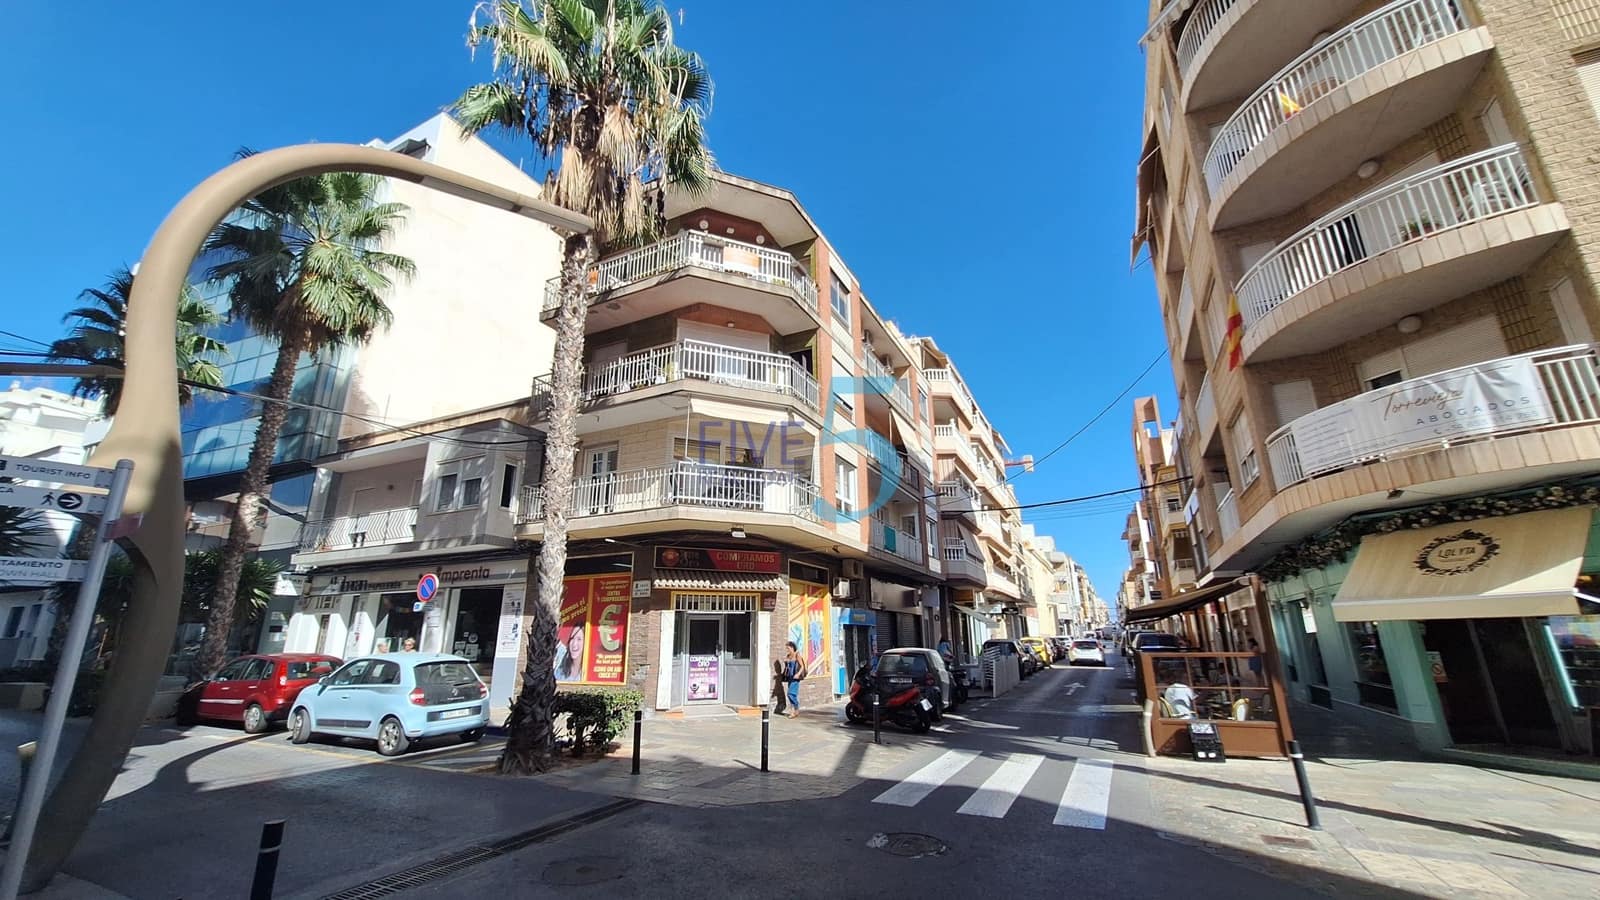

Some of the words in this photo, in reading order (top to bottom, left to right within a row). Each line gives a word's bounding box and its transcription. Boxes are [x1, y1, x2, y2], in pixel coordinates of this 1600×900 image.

[1416, 396, 1530, 425] ABOGADOS
[16, 464, 63, 476] TOURIST
[64, 471, 91, 480] INFO
[716, 551, 775, 564] COMPRAMOS
[31, 570, 59, 578] HALL
